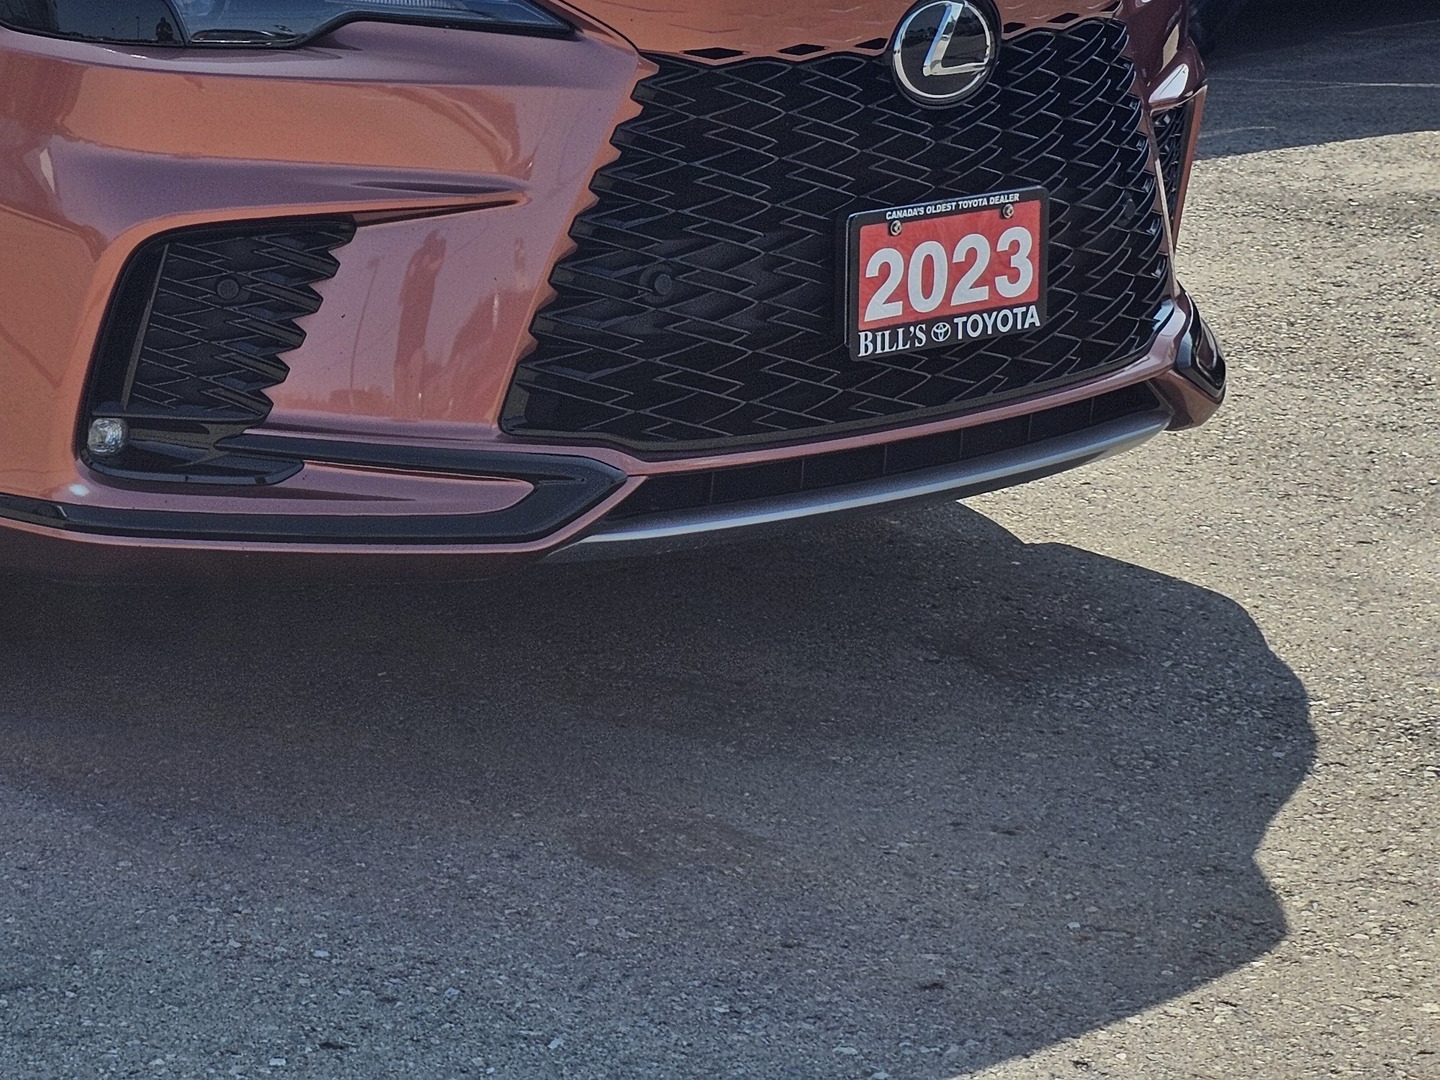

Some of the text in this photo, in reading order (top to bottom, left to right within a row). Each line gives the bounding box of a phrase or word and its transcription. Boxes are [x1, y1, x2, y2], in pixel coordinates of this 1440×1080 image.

[886, 193, 1020, 220] CANADA'S OLDEST TOYOTA DEALER
[864, 226, 1034, 322] 2023
[857, 305, 1041, 357] BILL'S TOYOTA
